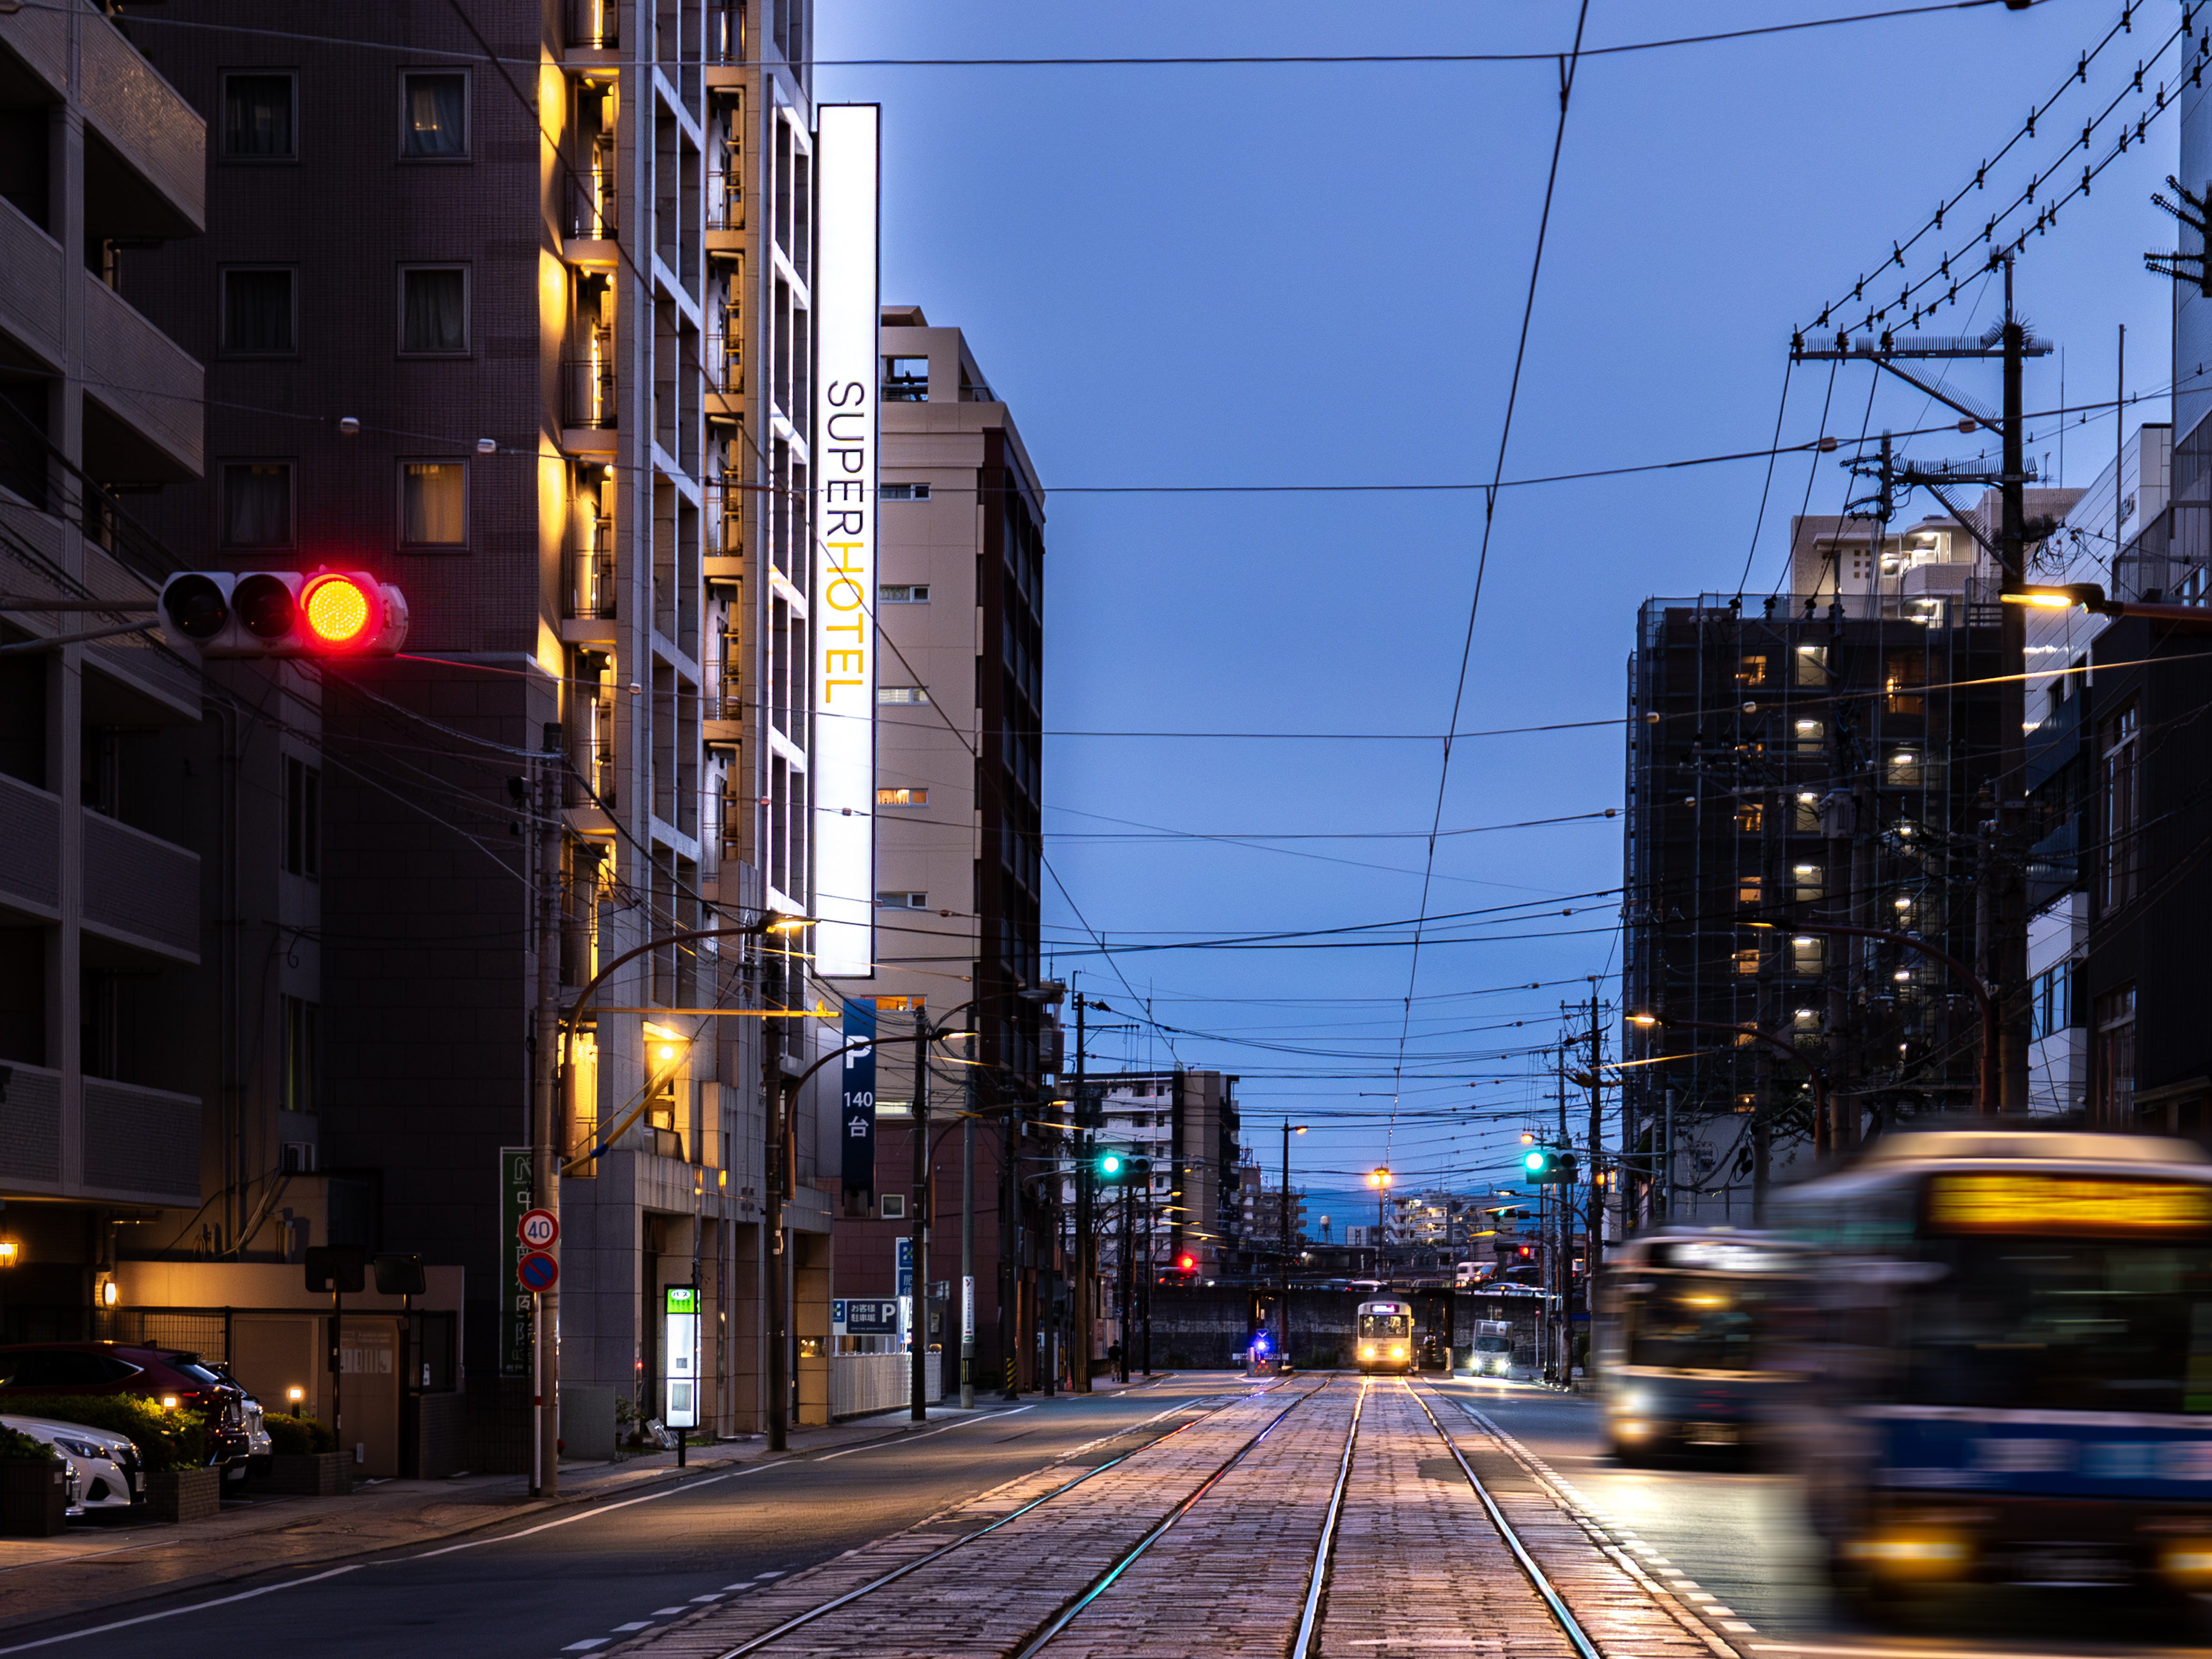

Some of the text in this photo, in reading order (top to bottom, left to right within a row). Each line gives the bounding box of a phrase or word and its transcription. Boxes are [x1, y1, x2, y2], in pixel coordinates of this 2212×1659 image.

[846, 1035, 872, 1069] P
[844, 1091, 873, 1107] 140
[848, 1115, 869, 1138] 台
[528, 1221, 550, 1238] 40
[882, 1303, 896, 1323] P
